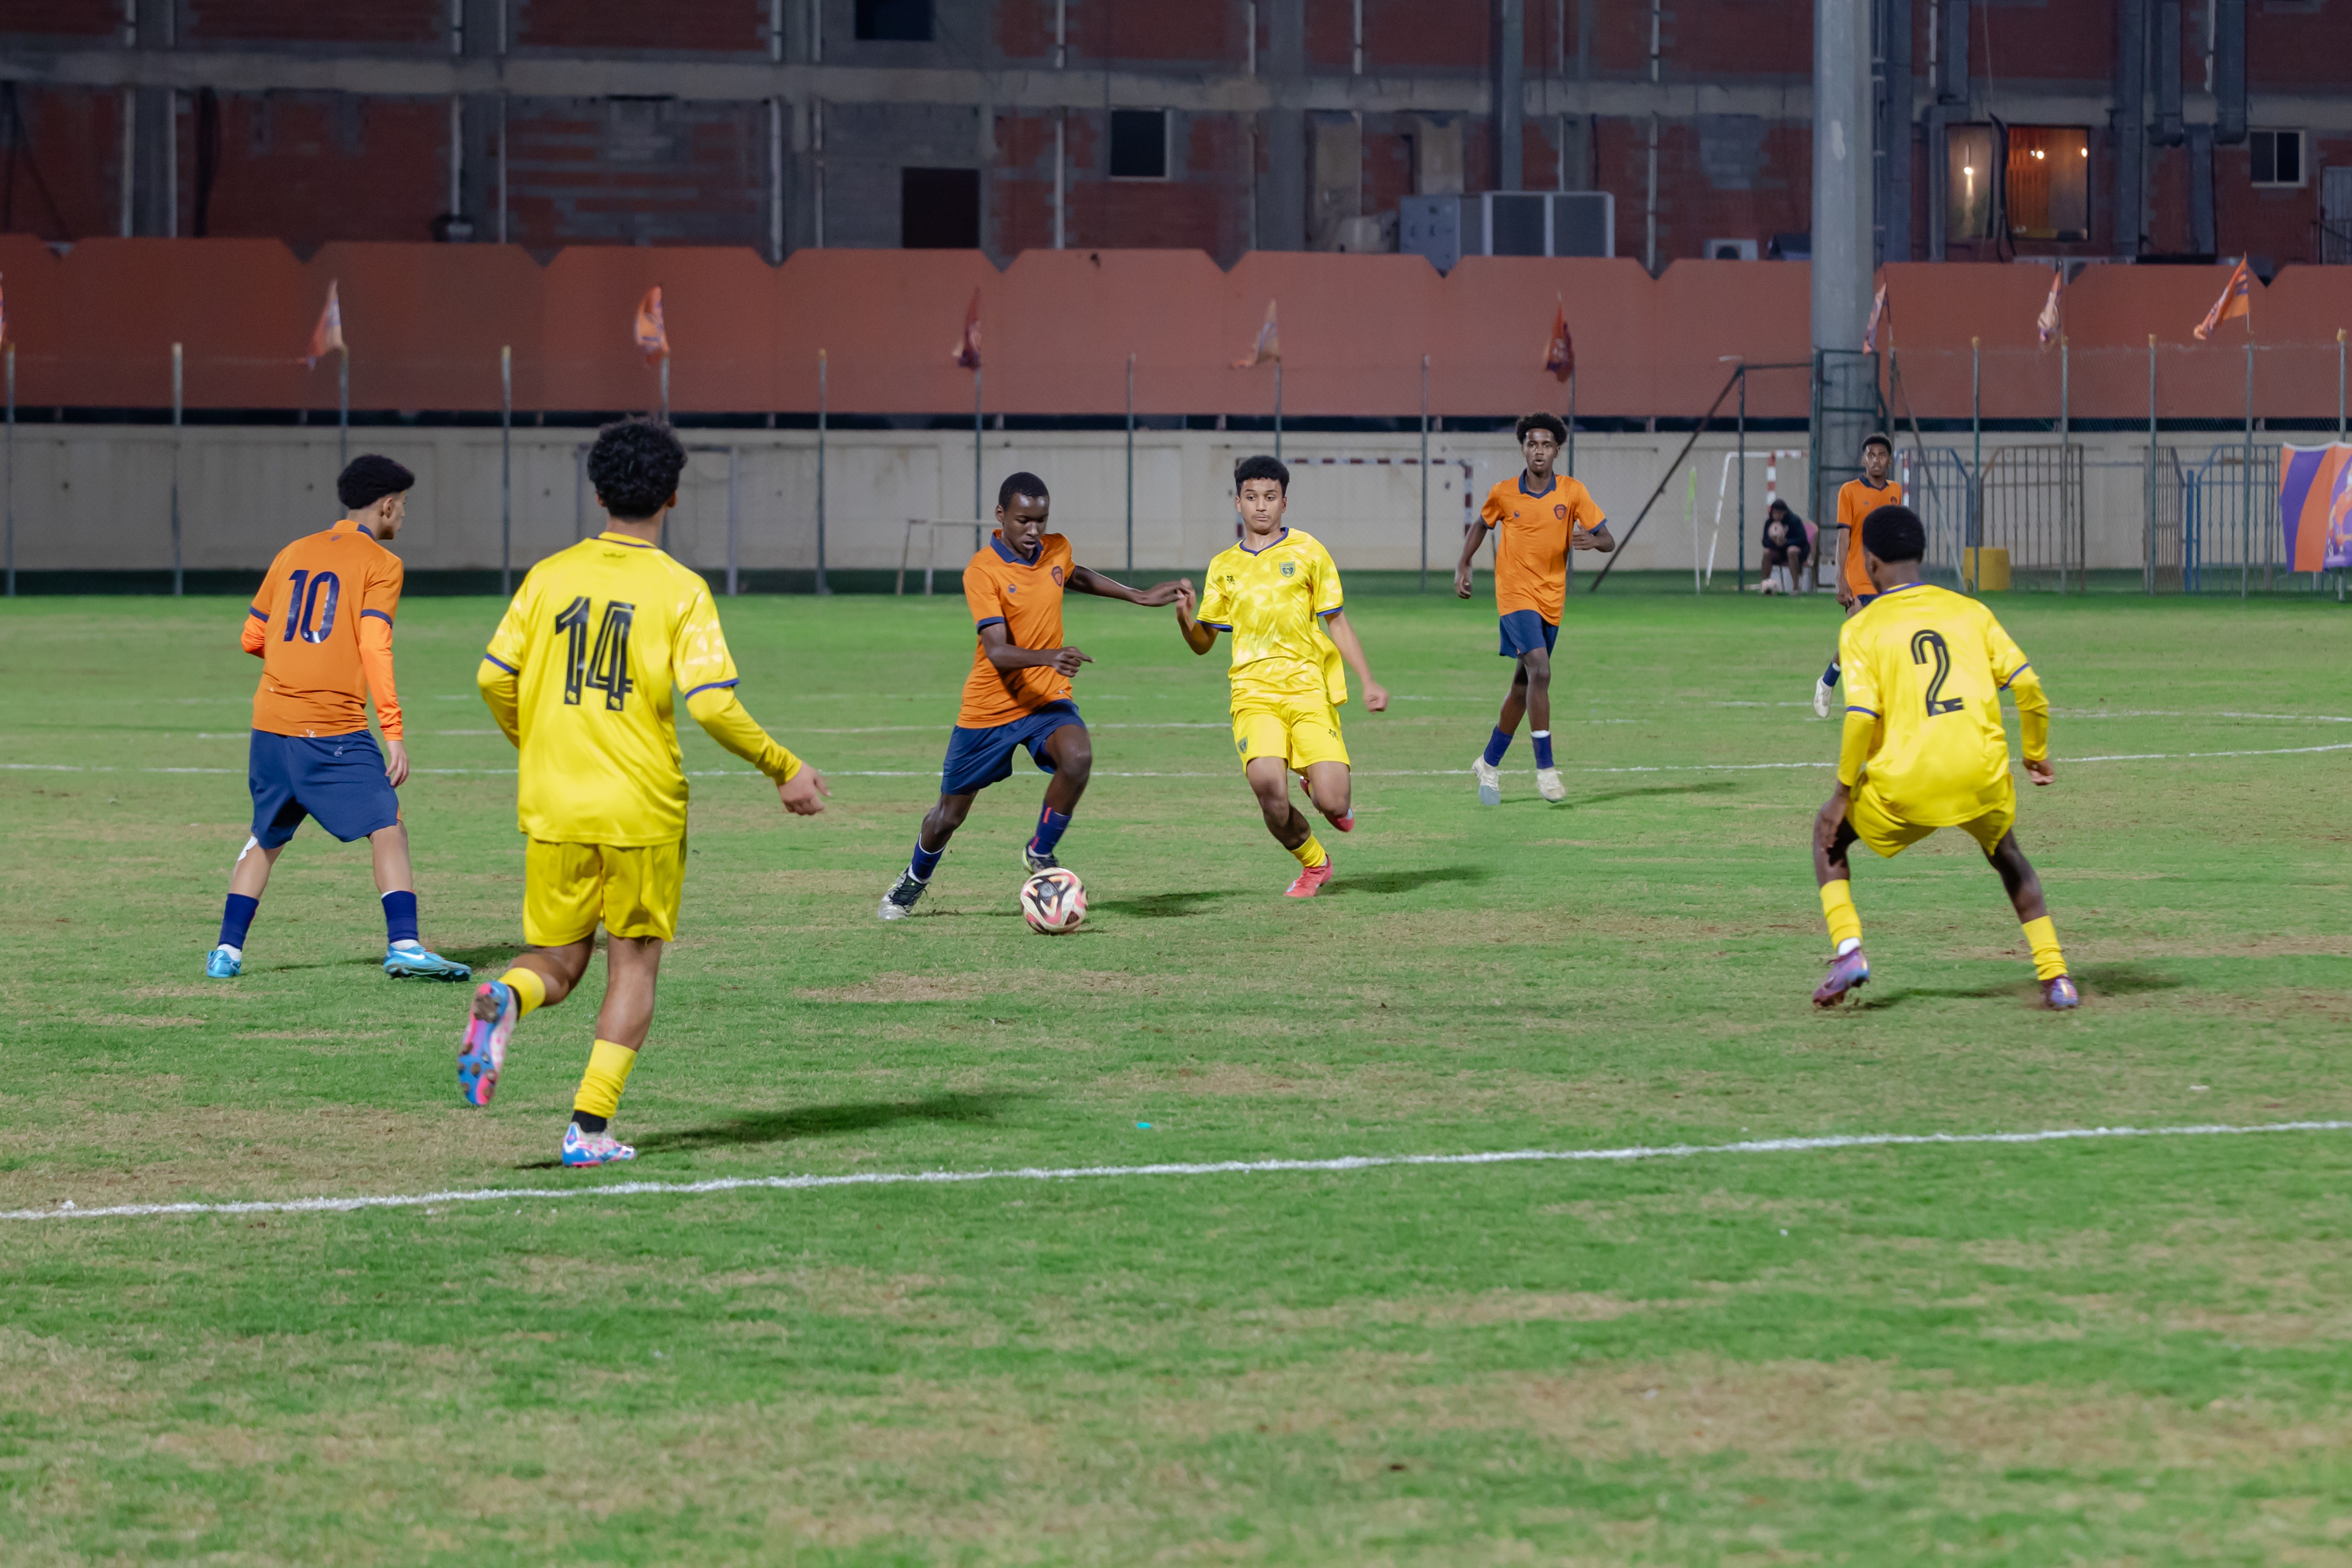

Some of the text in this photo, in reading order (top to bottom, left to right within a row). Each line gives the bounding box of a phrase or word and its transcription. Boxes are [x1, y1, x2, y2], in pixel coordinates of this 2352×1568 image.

[283, 569, 340, 643] 10
[555, 596, 636, 712] 14
[1911, 629, 1965, 717] 2
